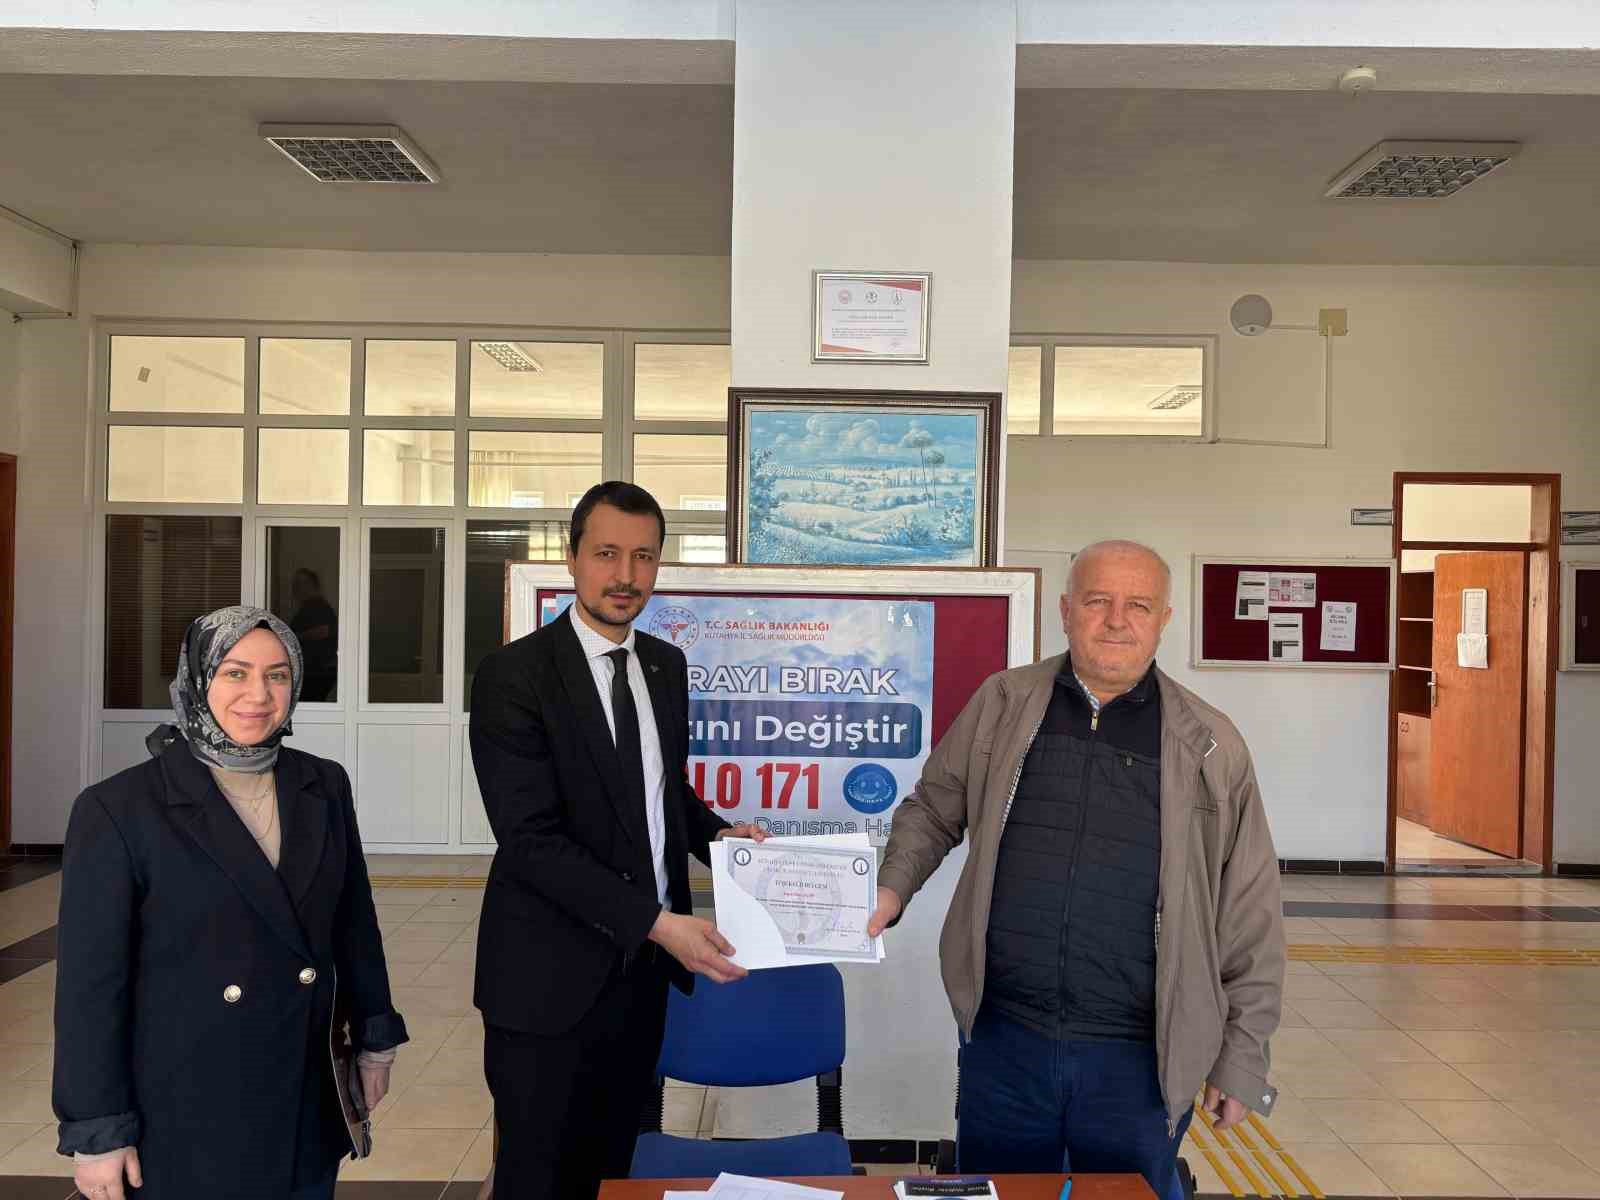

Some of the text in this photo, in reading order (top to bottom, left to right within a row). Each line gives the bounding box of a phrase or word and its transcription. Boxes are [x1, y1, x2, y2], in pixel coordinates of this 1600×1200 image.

[768, 621, 829, 632] BAKANLIĞI
[687, 664, 899, 695] RAYI BIRAK
[755, 714, 907, 750] Değiştir
[687, 762, 742, 810] LO
[756, 762, 820, 810] 171
